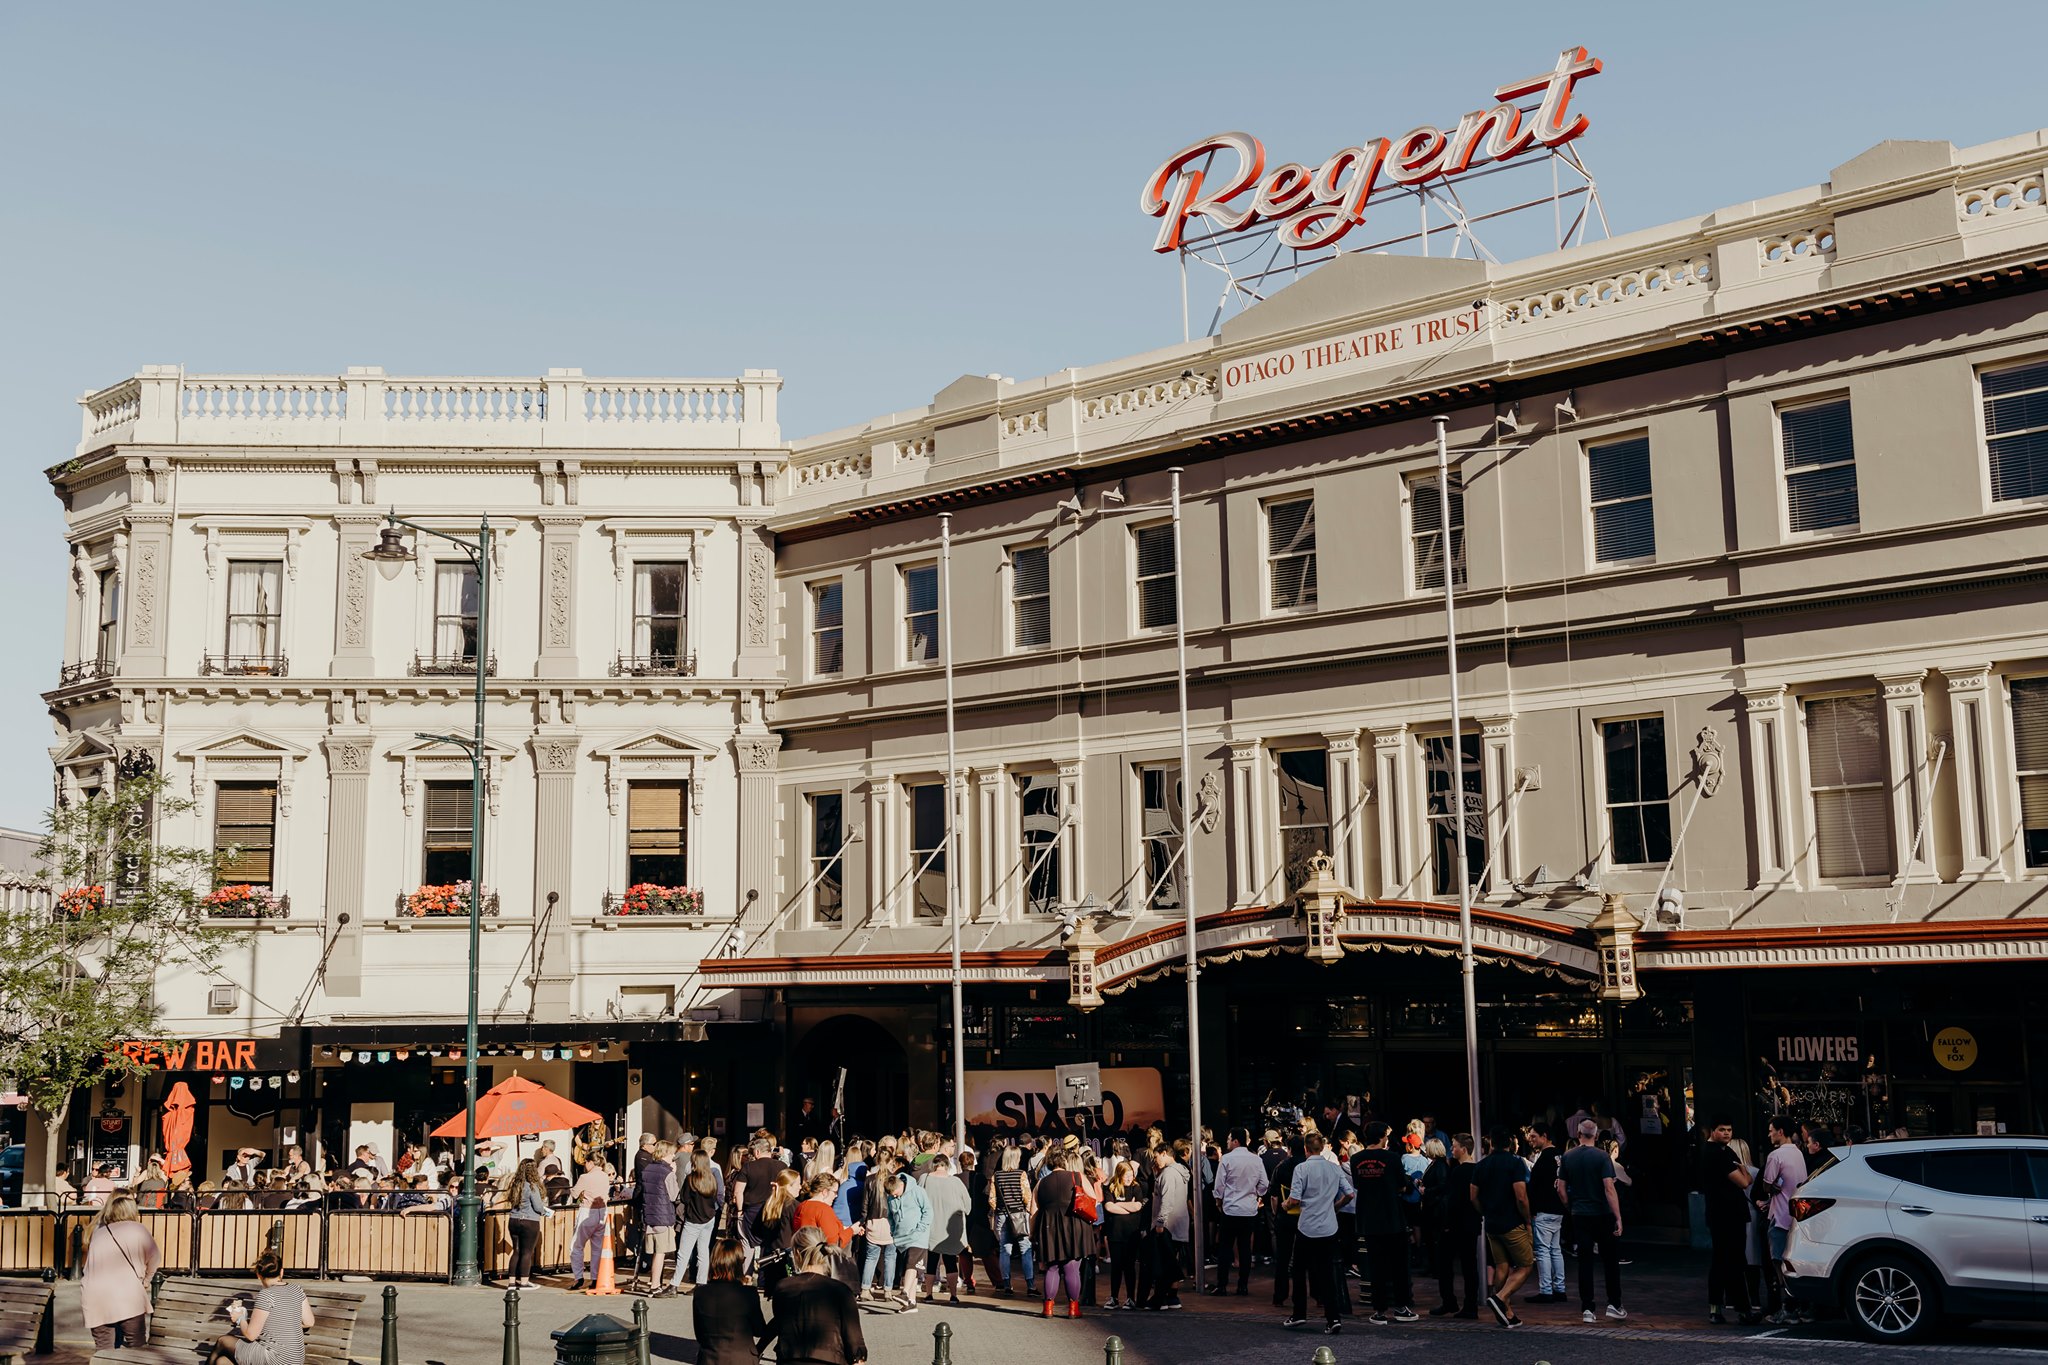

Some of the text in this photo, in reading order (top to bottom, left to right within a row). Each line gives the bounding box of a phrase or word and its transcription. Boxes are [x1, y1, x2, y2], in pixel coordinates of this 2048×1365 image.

[1140, 45, 1603, 253] Regent
[1225, 309, 1484, 388] OTAGO THEATRE TRUST
[124, 797, 144, 885] ACCUS
[196, 1040, 256, 1070] BAR
[1777, 1036, 1859, 1062] FLOWERS
[1937, 1038, 1972, 1046] FALLOW
[1952, 1046, 1959, 1054] &
[1947, 1054, 1965, 1062] FOX
